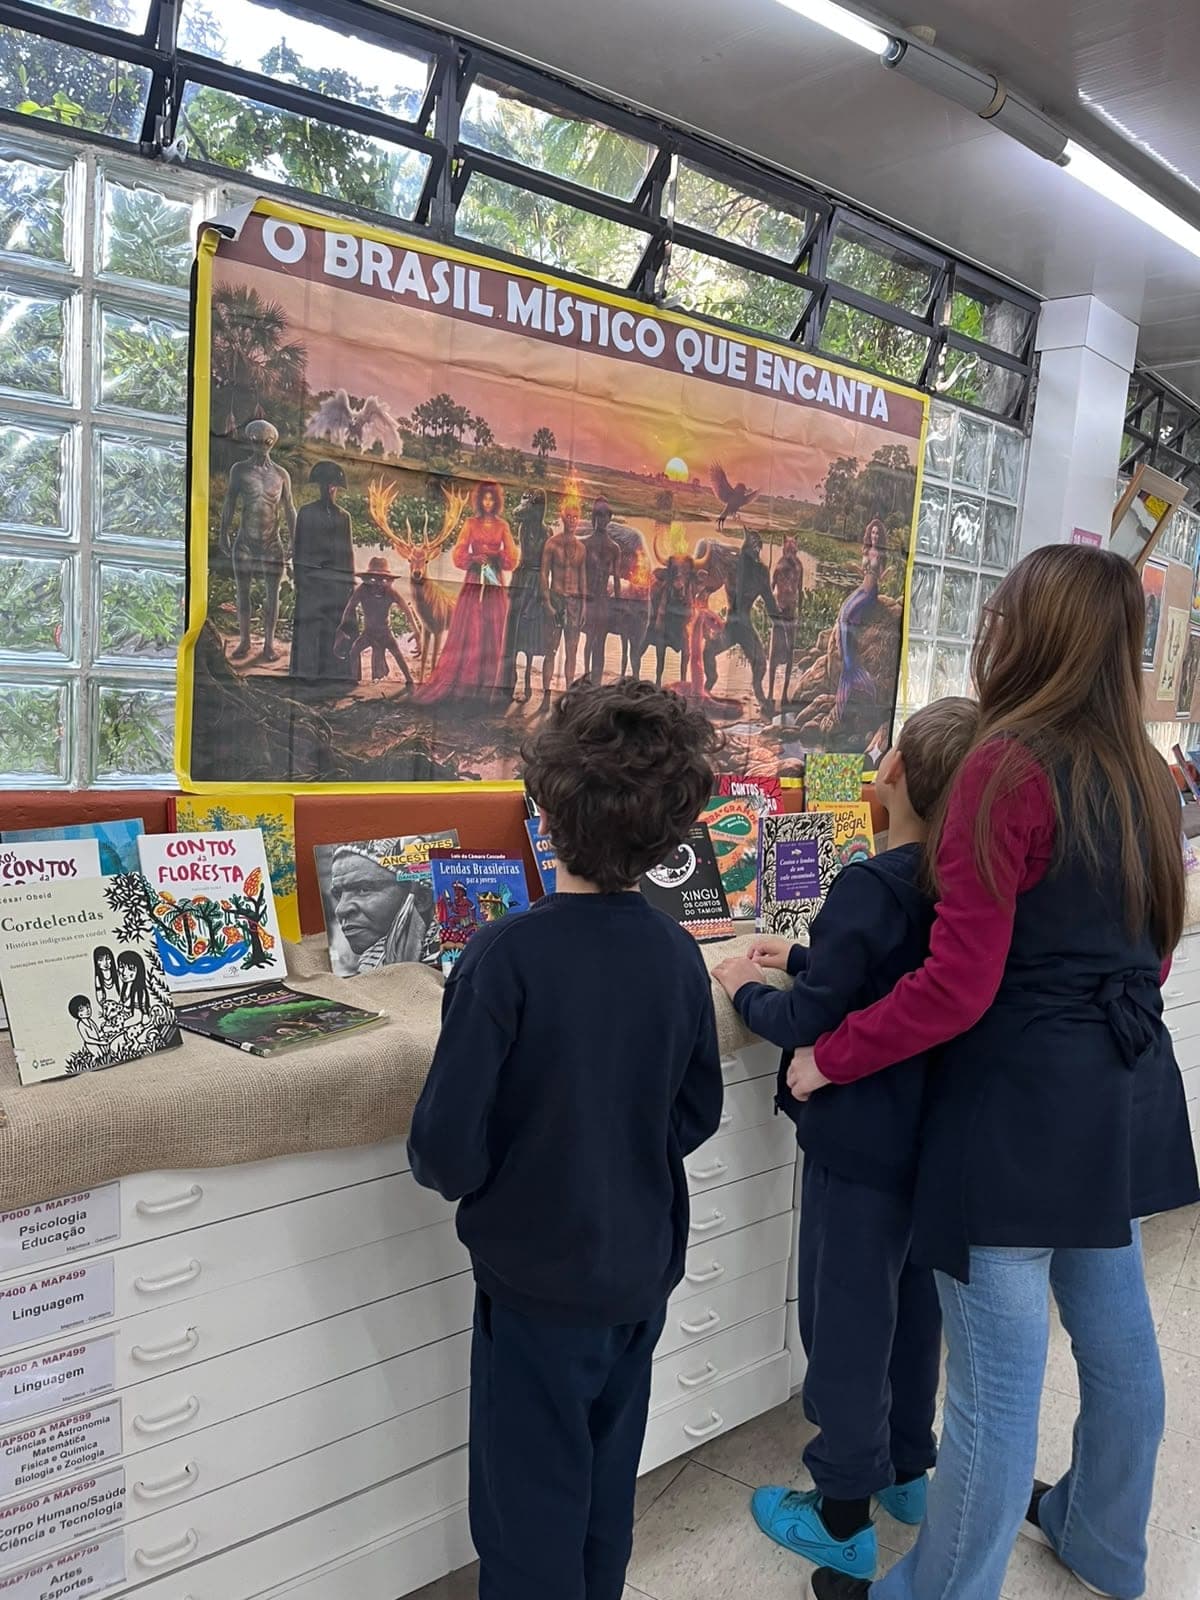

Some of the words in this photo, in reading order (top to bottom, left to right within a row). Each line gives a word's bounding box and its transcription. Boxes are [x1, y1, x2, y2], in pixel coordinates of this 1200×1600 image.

[262, 216, 306, 264] O
[323, 230, 494, 318] BRASIL
[507, 280, 665, 359] MÍSTICO
[676, 329, 748, 381] QUE
[755, 349, 890, 422] ENCANTA
[166, 838, 237, 857] CONTOS
[414, 839, 452, 852] VOZES
[2, 858, 78, 879] CONTOS
[382, 853, 428, 866] ANCEST
[439, 862, 471, 875] Lendas
[473, 862, 521, 875] Brasileiras
[158, 862, 244, 883] FLORESTA
[681, 887, 719, 901] XINGU
[694, 900, 721, 908] CONTOS
[1, 909, 104, 932] Cordelendas
[5, 940, 39, 951] Histórias
[40, 934, 73, 945] indígenas
[211, 989, 290, 1012] FOLCLORE
[0, 1208, 31, 1223] P000
[34, 1206, 42, 1214] A
[19, 1210, 88, 1237] Psicologia
[21, 1225, 86, 1251] Educação
[30, 1283, 38, 1292] A
[41, 1269, 87, 1289] MAP499
[12, 1292, 85, 1321] Linguagem
[31, 1360, 39, 1370] A
[42, 1346, 87, 1366] MAP499
[14, 1367, 85, 1395] Linguagem
[0, 1430, 36, 1448] AP500
[39, 1427, 47, 1436] A
[49, 1412, 92, 1432] MAP599
[5, 1438, 47, 1456] Ciências
[57, 1415, 111, 1439] Astronomia
[32, 1434, 86, 1458] Matemática
[60, 1441, 98, 1459] Química
[14, 1467, 54, 1486] Biologia
[64, 1449, 105, 1469] Zoologia
[42, 1496, 51, 1505] A
[53, 1479, 97, 1501] MAP699
[0, 1521, 34, 1539] Corpo
[37, 1486, 127, 1526] Humano/Saúde
[0, 1529, 46, 1553] Ciência
[48, 1526, 56, 1534] e
[59, 1500, 123, 1530] Tecnologia
[46, 1563, 54, 1571] A
[50, 1567, 83, 1586] Artes
[40, 1575, 94, 1600] Esportes
